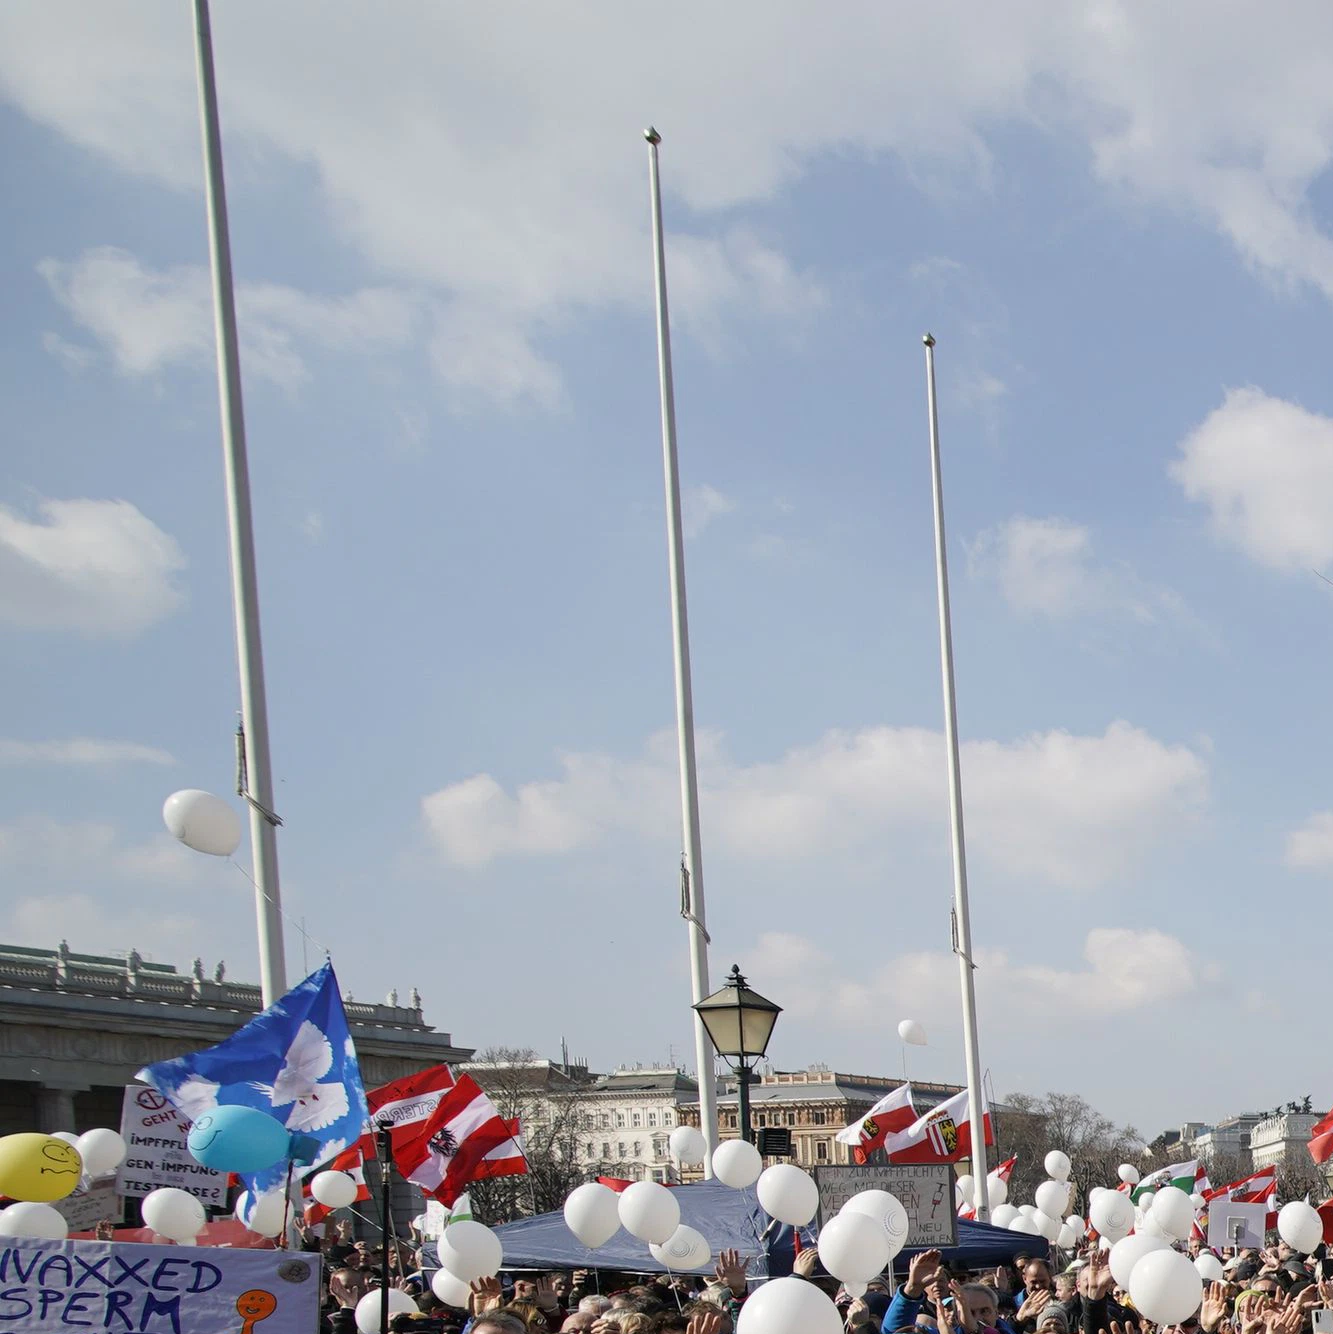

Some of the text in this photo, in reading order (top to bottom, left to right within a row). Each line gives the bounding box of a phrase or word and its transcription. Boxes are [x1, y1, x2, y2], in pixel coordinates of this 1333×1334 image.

[142, 1110, 177, 1127] GEHT
[849, 1168, 871, 1178] ZUR
[820, 1183, 846, 1194] WEG
[880, 1180, 917, 1193] DIESER
